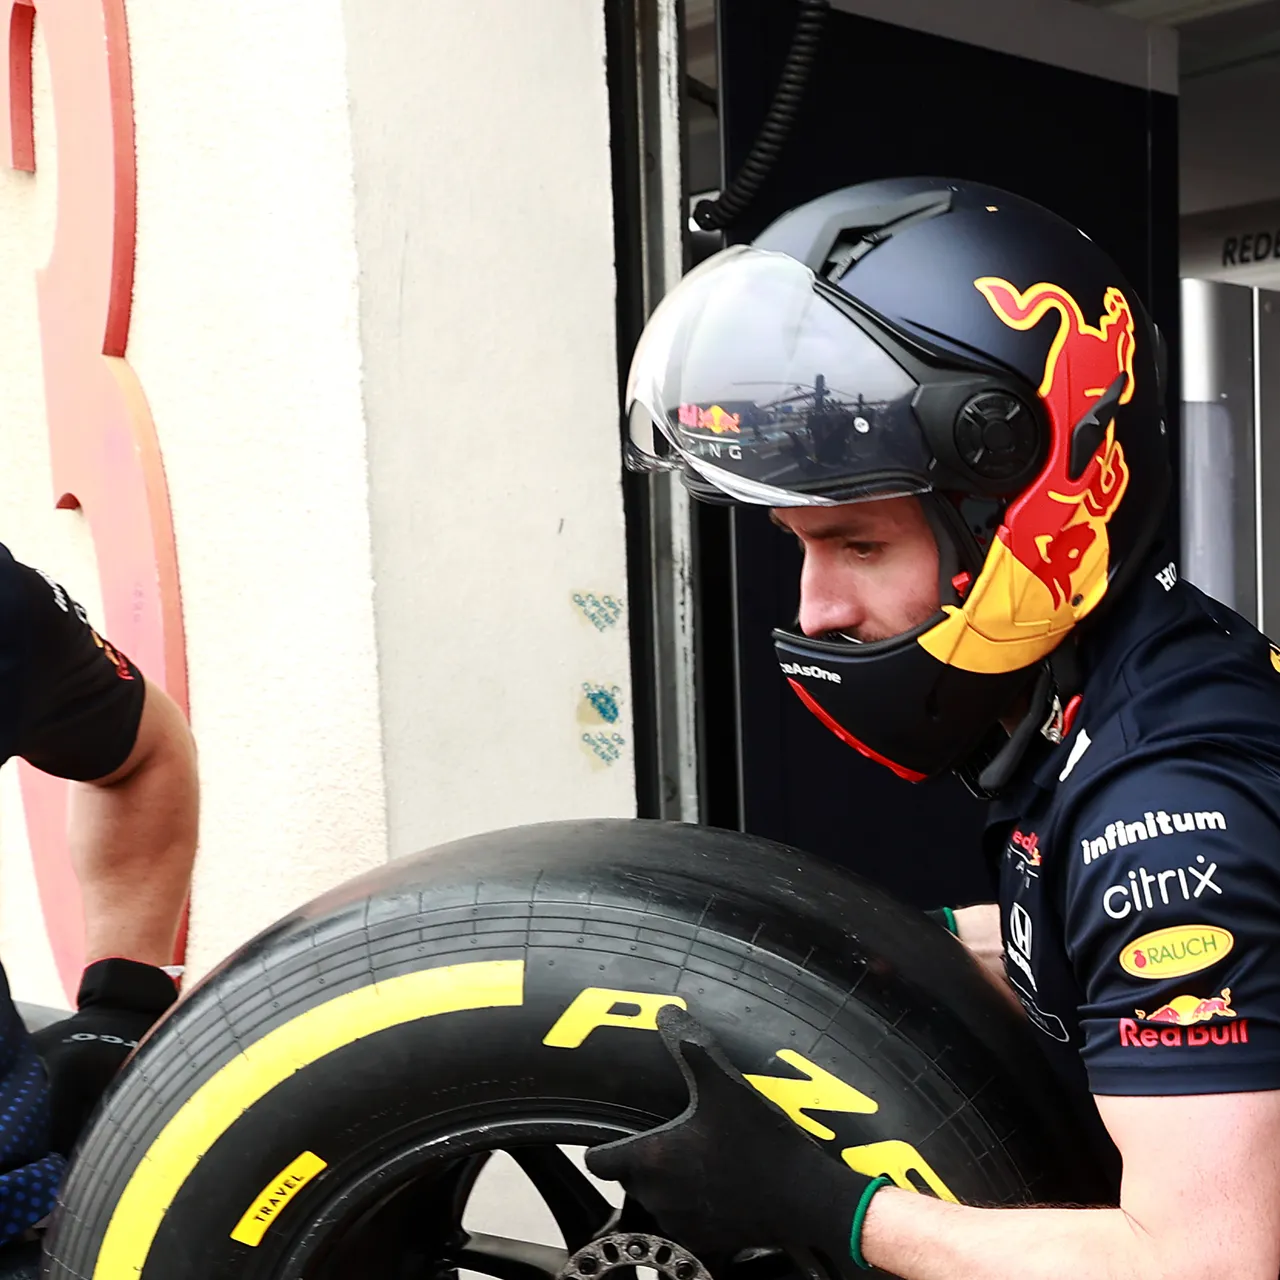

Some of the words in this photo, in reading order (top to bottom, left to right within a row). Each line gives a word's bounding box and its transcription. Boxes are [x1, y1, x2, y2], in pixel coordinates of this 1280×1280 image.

[1080, 811, 1227, 865] infinitum
[1103, 854, 1222, 919] citrix
[1148, 934, 1218, 965] RAUCH
[1187, 1020, 1249, 1048] Bull
[253, 1174, 305, 1222] TRAVEL
